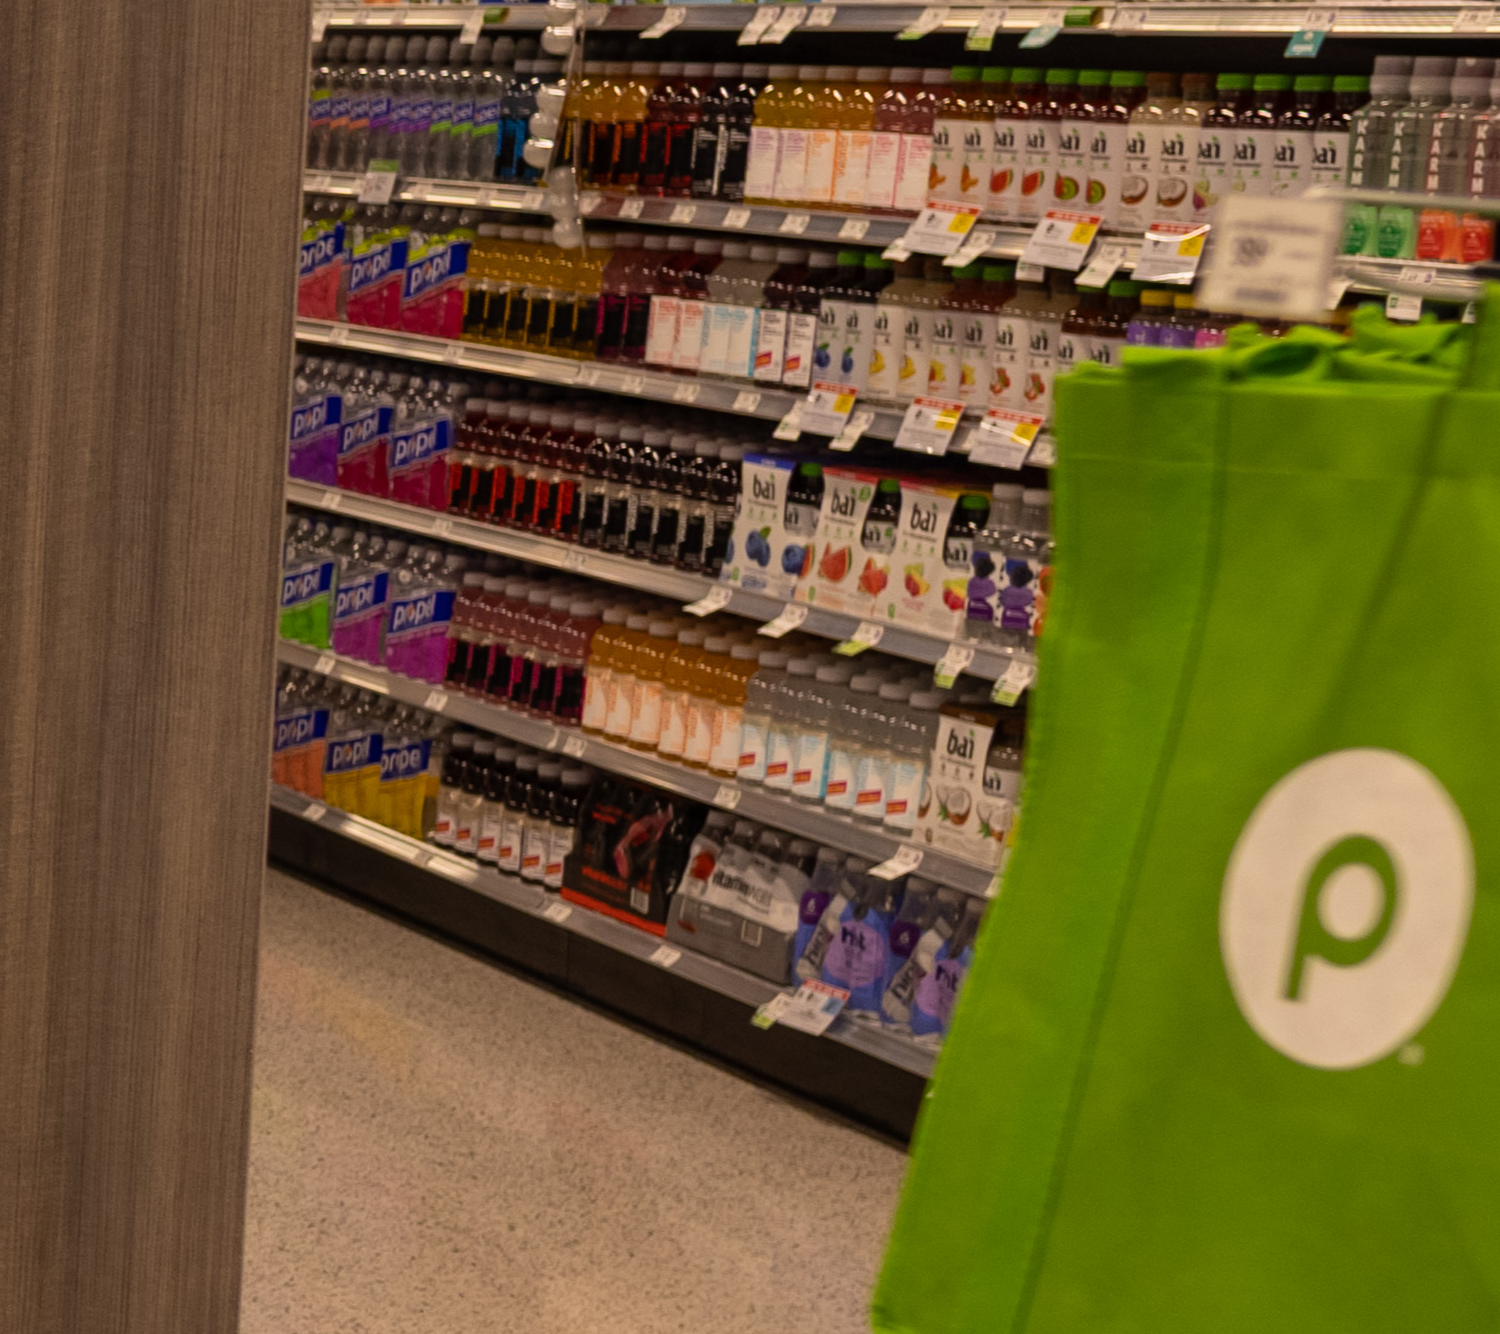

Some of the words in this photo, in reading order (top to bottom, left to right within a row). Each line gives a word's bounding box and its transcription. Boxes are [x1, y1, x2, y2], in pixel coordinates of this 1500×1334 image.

[752, 472, 776, 501] bai
[830, 485, 855, 517] bai
[910, 501, 938, 534] bai
[946, 727, 975, 760] bai
